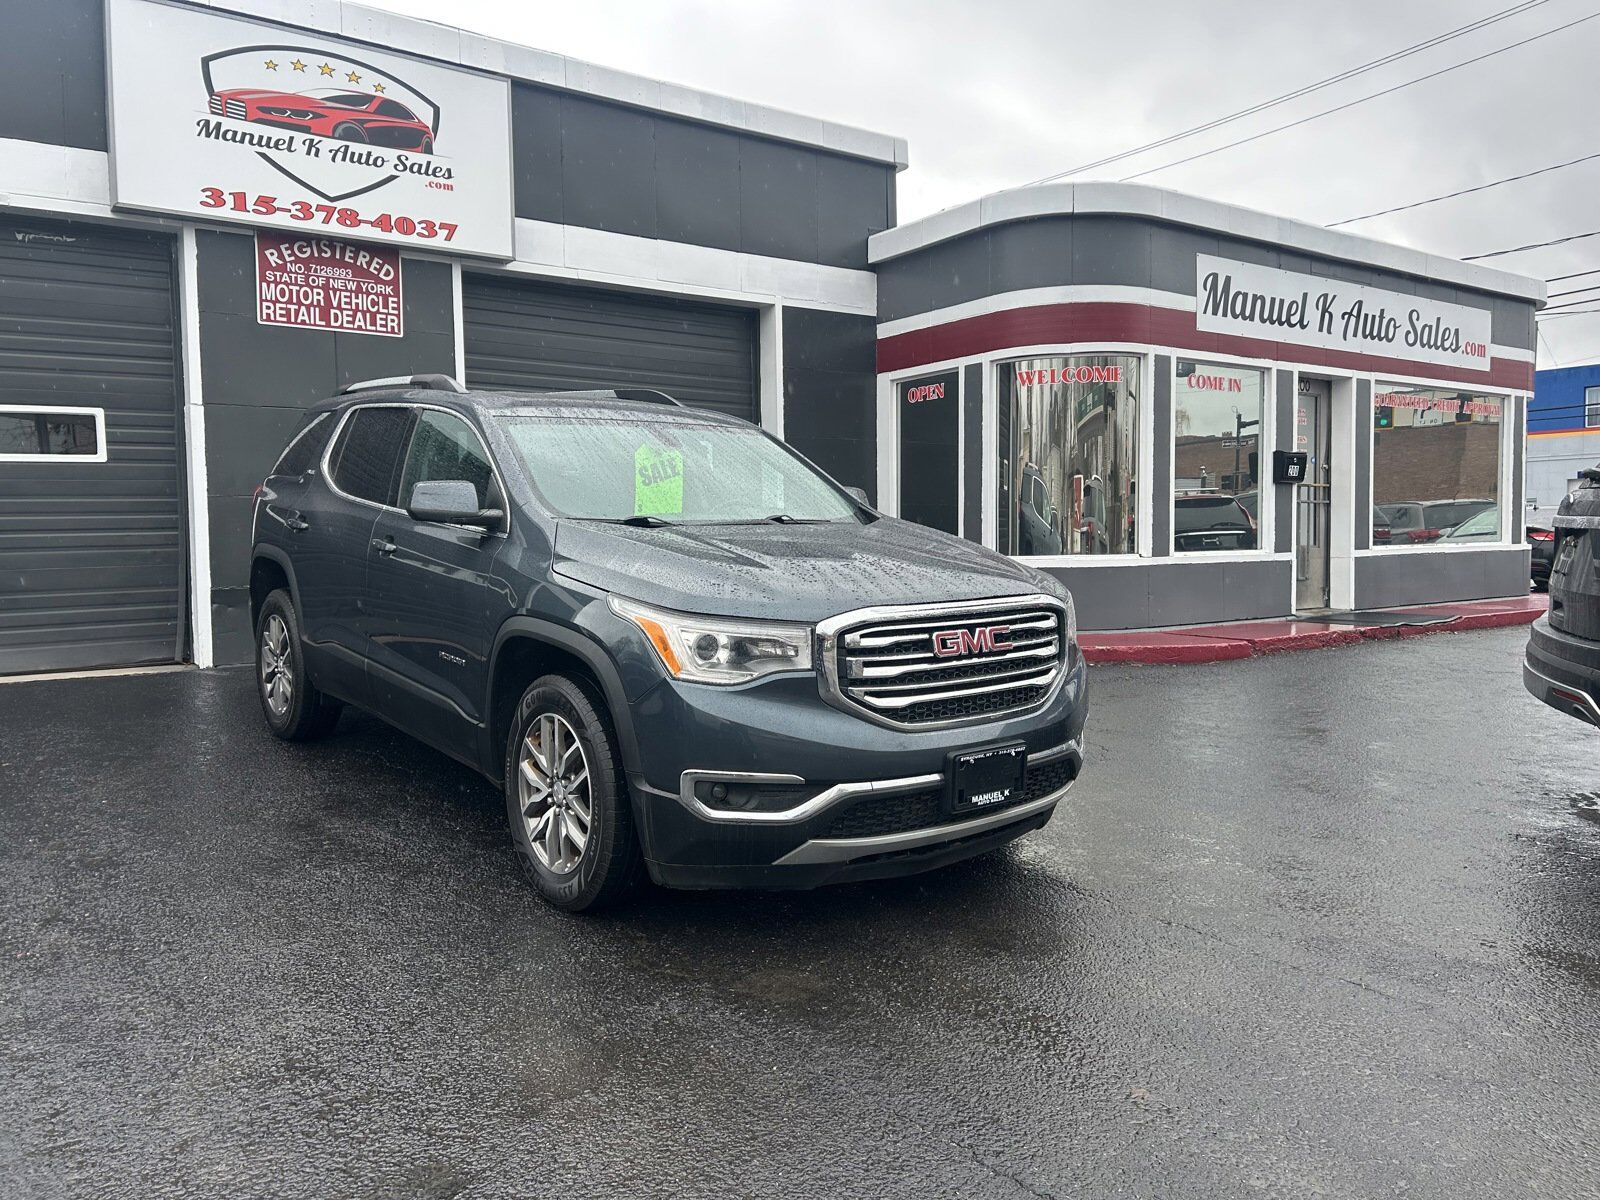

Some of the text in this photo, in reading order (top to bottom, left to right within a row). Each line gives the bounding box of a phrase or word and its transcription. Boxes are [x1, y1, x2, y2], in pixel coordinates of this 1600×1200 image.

[196, 118, 455, 180] Manuel K Auto Sales
[424, 180, 454, 191] .com
[199, 187, 458, 242] 315-378-4037
[264, 240, 395, 281] REGISTERED
[286, 263, 353, 278] NO. 7126993
[265, 270, 394, 295] STATE OF NEW YORK
[261, 282, 399, 314] MOTOR VEHICLE
[1202, 272, 1310, 330] Manuel
[1315, 293, 1338, 335] K
[1341, 299, 1401, 341] Auto
[262, 302, 399, 333] RETAIL DEALER
[1018, 366, 1123, 387] WELCOME
[1187, 373, 1242, 393] COME IN
[1297, 380, 1311, 392] 00
[907, 383, 945, 403] OPEN
[639, 459, 681, 486] SALE
[932, 625, 1014, 658] GMC
[972, 791, 1002, 803] MANUEL
